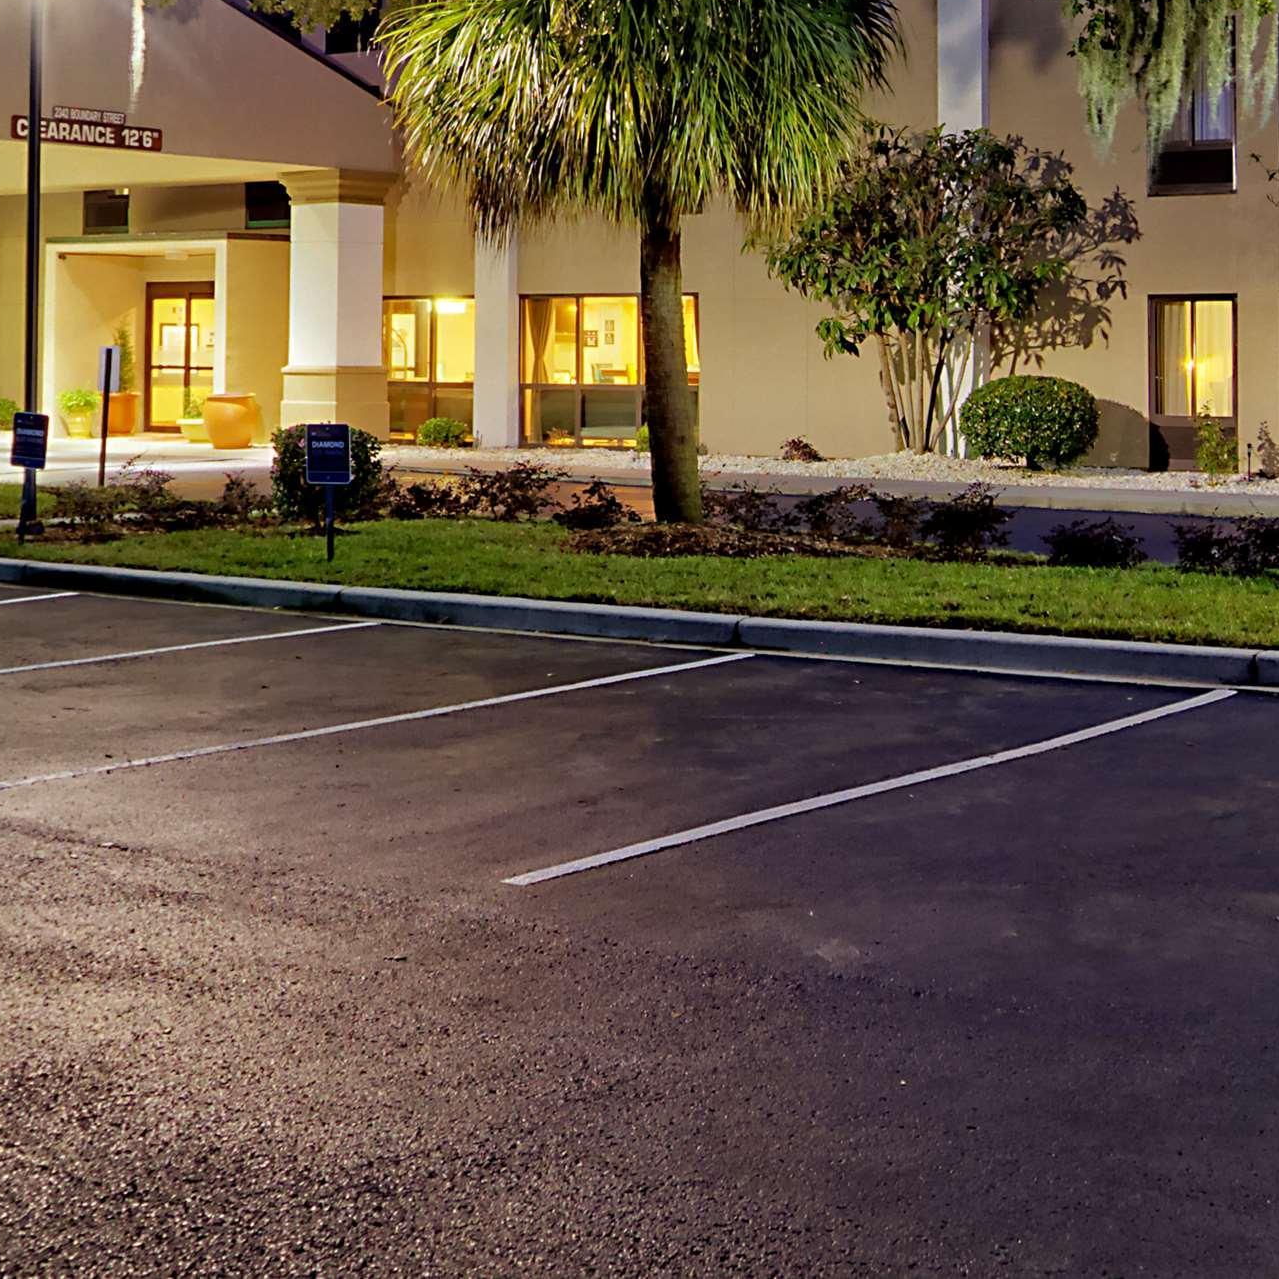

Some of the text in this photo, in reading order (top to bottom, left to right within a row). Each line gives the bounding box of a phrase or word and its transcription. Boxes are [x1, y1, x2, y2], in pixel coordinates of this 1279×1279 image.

[103, 111, 125, 124] STREET
[16, 119, 159, 148] CEARANCE 12'6"
